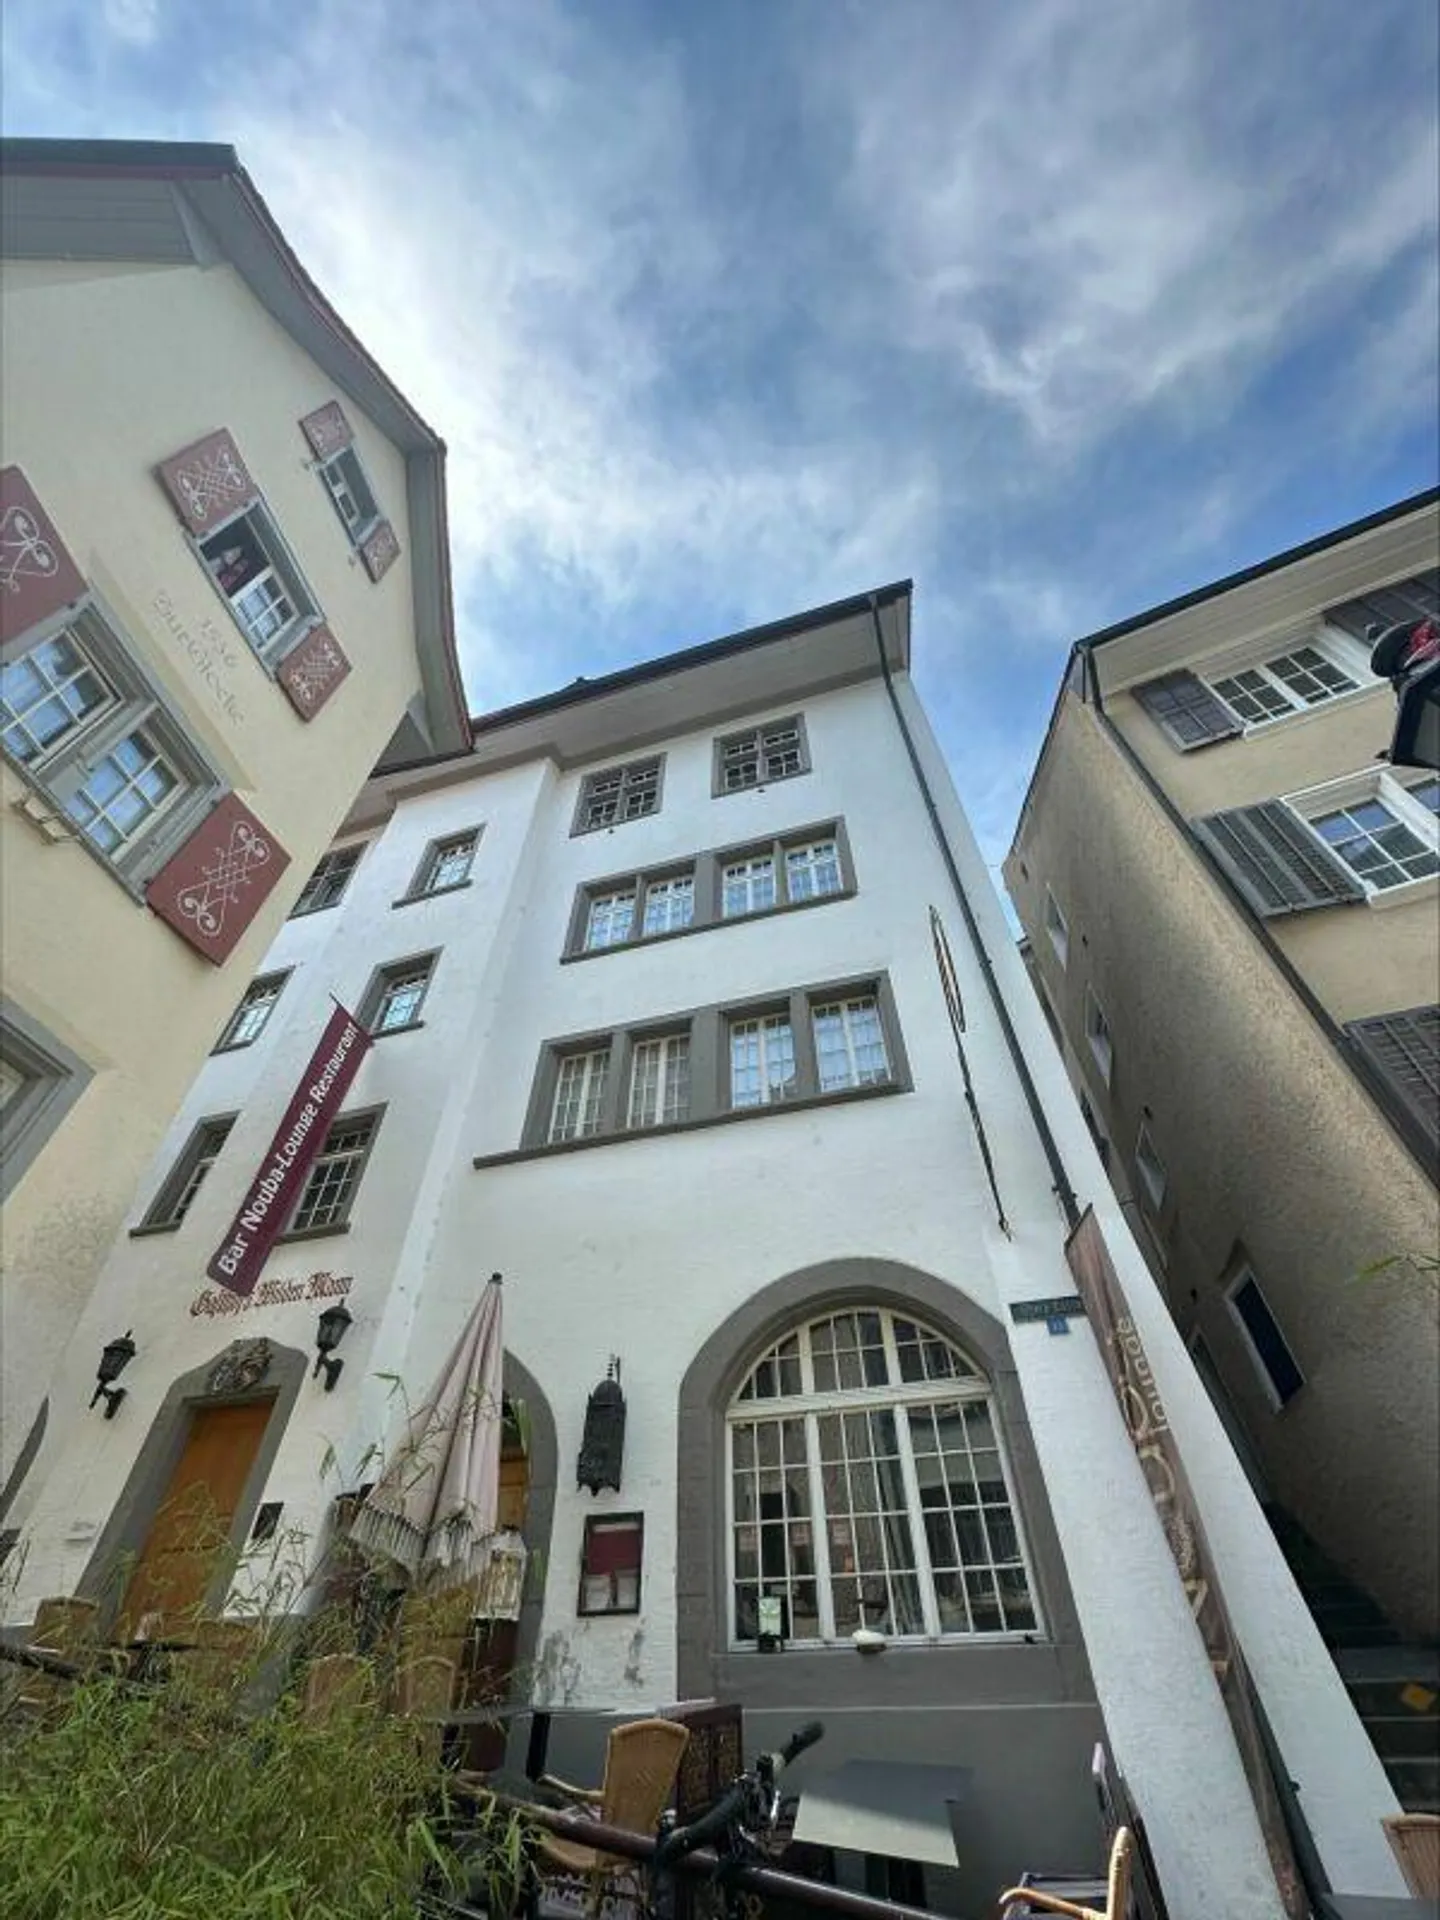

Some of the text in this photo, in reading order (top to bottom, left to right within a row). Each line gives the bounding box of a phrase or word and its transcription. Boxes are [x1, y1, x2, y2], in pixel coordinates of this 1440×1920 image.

[217, 1022, 359, 1277] Bar Nouba-Lounge Restaurant
